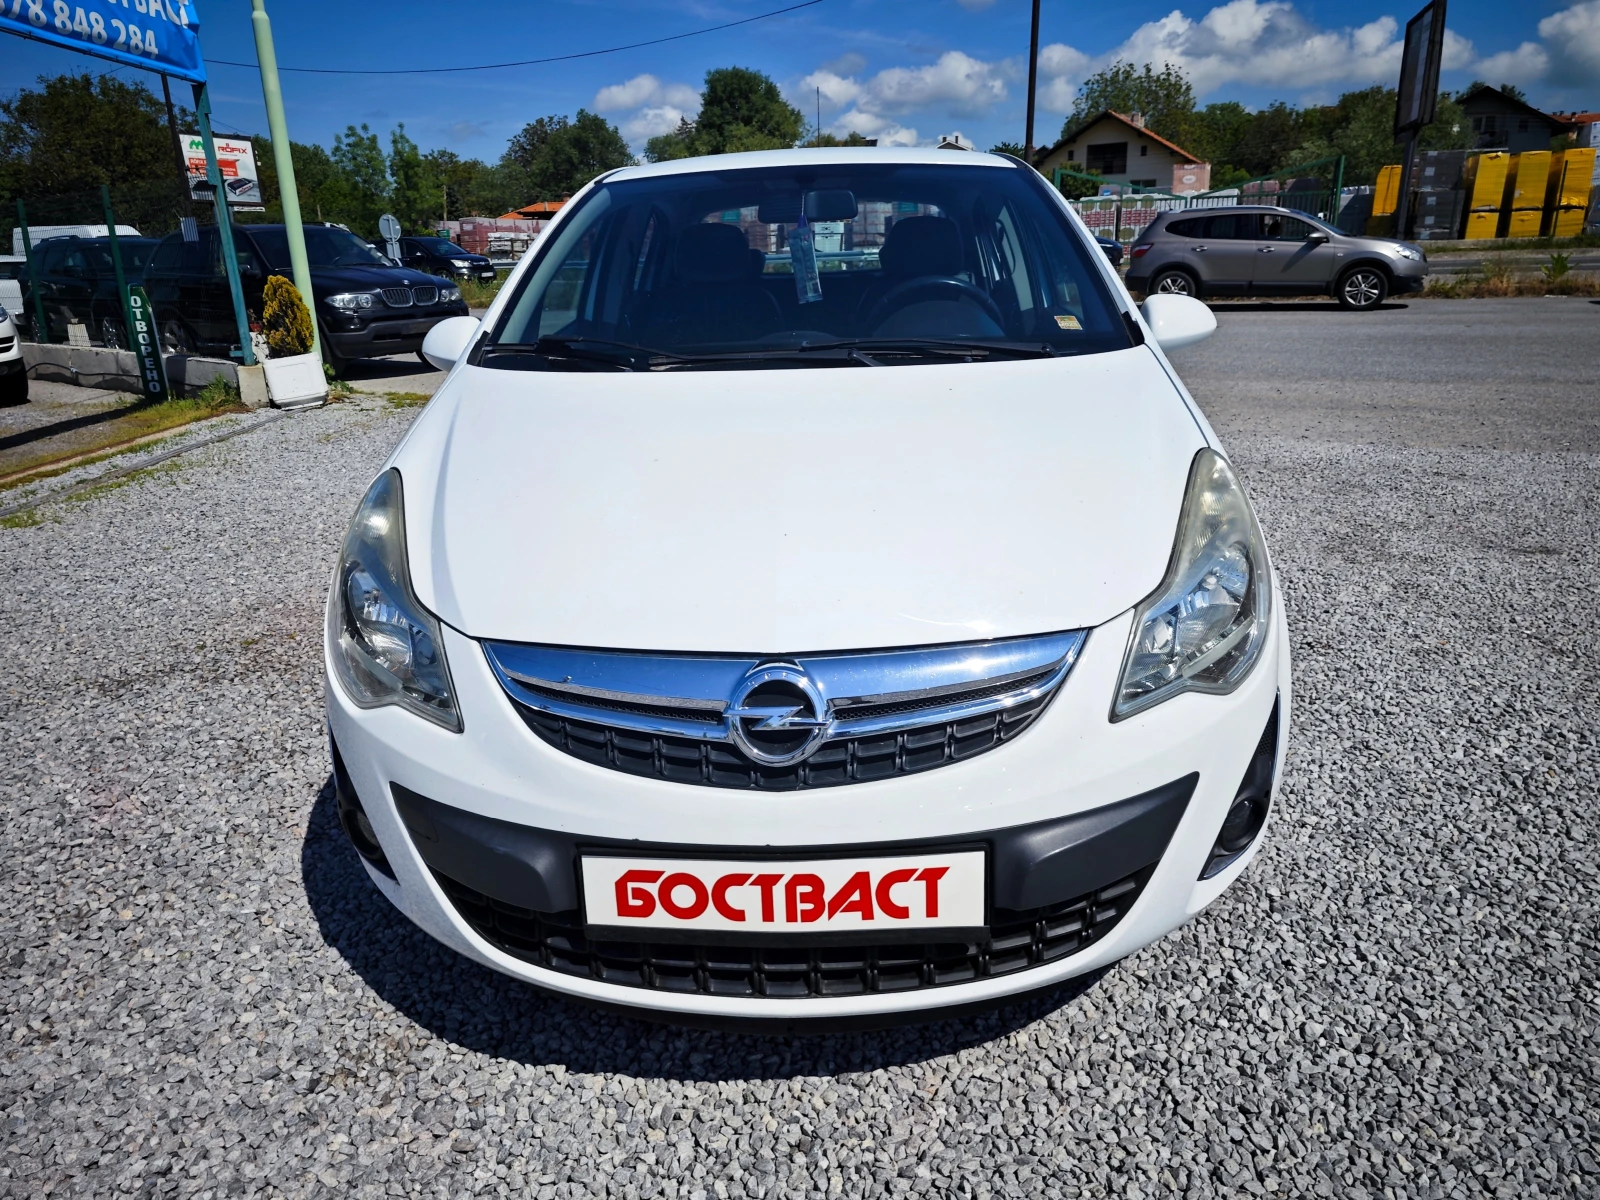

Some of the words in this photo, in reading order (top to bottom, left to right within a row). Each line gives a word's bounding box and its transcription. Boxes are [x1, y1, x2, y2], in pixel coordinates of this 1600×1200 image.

[53, 1, 108, 44] 848
[110, 18, 159, 59] 284
[131, 296, 160, 393] ОТВОРЕНО
[614, 867, 950, 922] БОСТВАСТ
